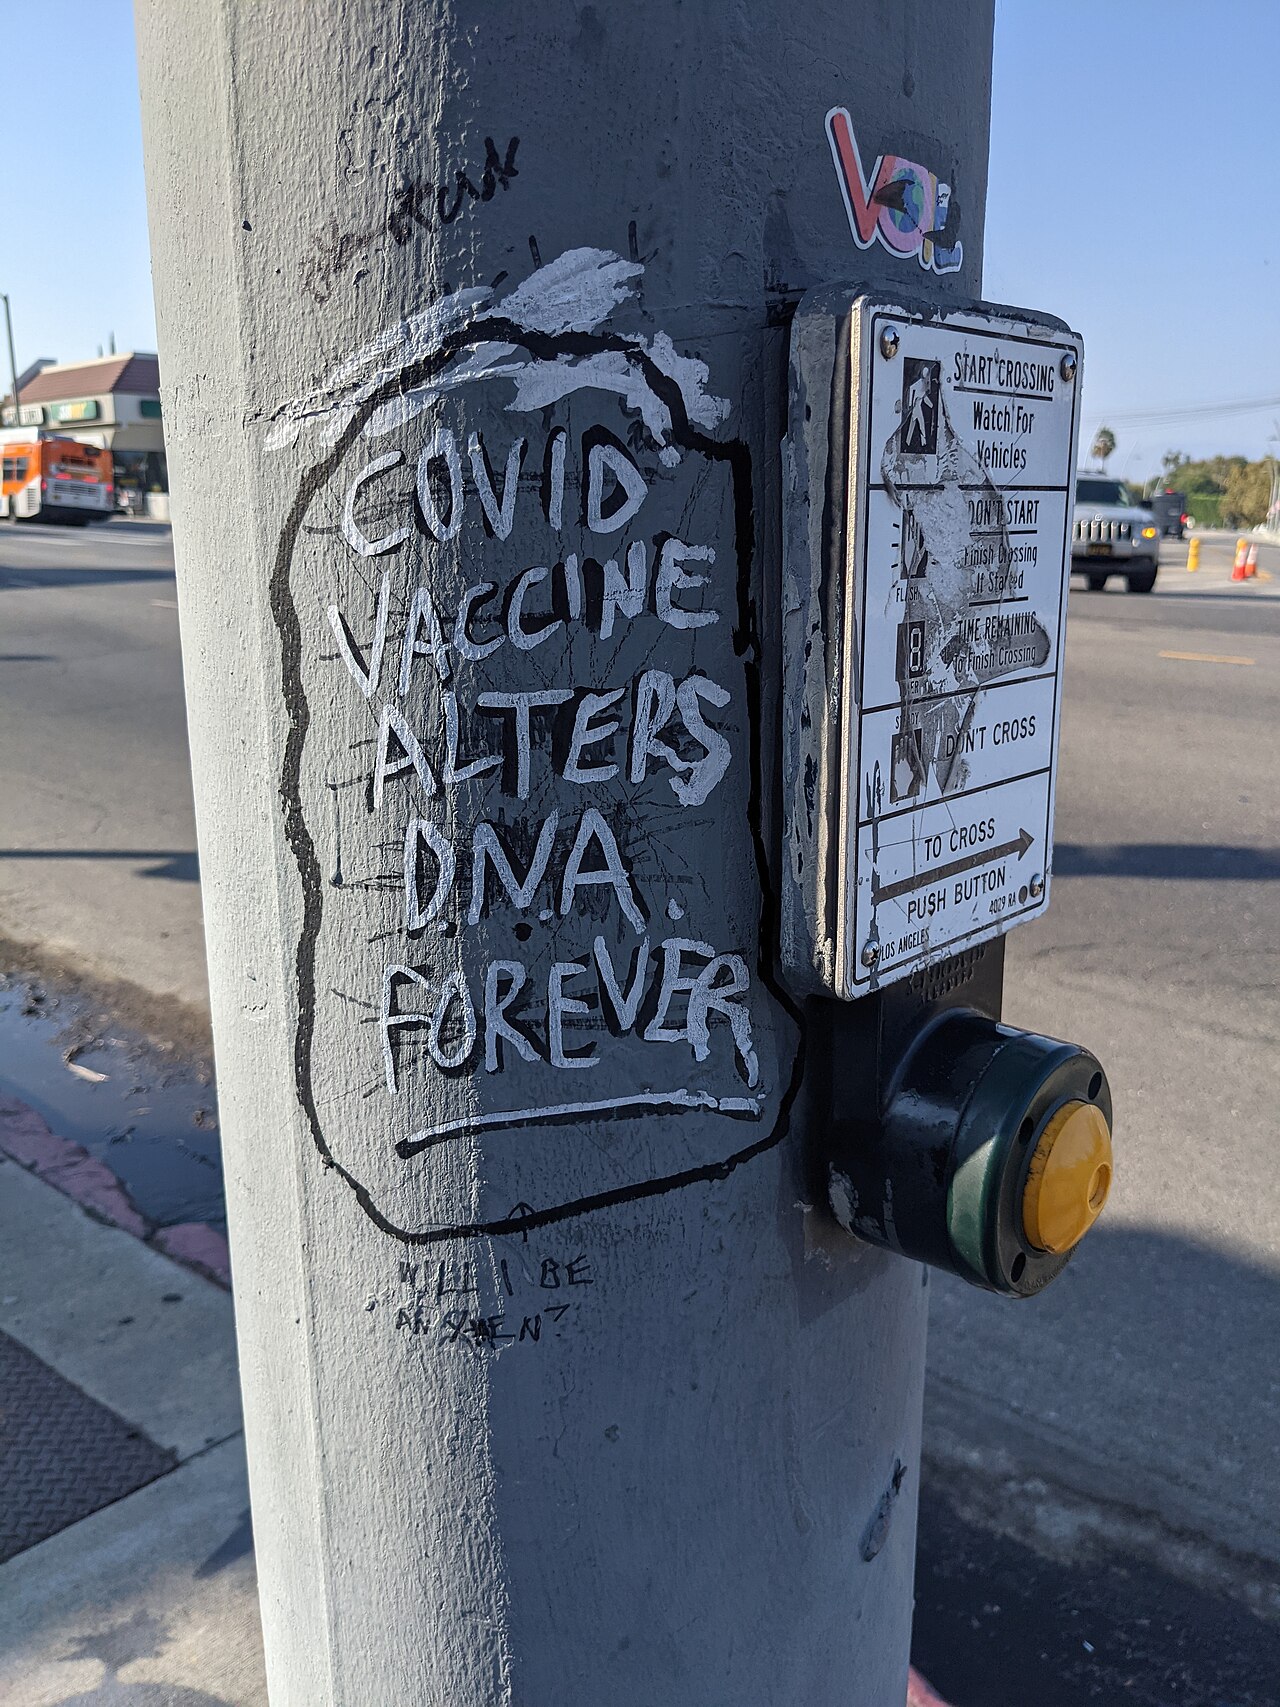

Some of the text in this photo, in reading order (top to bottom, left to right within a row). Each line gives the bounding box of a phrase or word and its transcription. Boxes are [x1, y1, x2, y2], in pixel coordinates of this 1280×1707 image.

[954, 351, 1055, 393] START CROSSING
[973, 401, 1035, 434] Watch For
[977, 440, 1027, 469] Vehicles
[1007, 500, 1040, 525] START
[327, 537, 720, 698] VACCINE
[958, 610, 1037, 643] TIME REMAINING
[967, 647, 995, 673] Finish
[999, 643, 1037, 667] Crossing
[373, 669, 732, 808] ALTERS
[993, 715, 1036, 746] CROSS
[924, 817, 996, 862] TO CROSS
[907, 865, 1006, 924] PUSH BUTTON
[880, 925, 931, 962] LOS ANGELES
[381, 935, 760, 1095] FOREVER
[500, 1258, 515, 1297] I
[539, 1252, 595, 1290] BE
